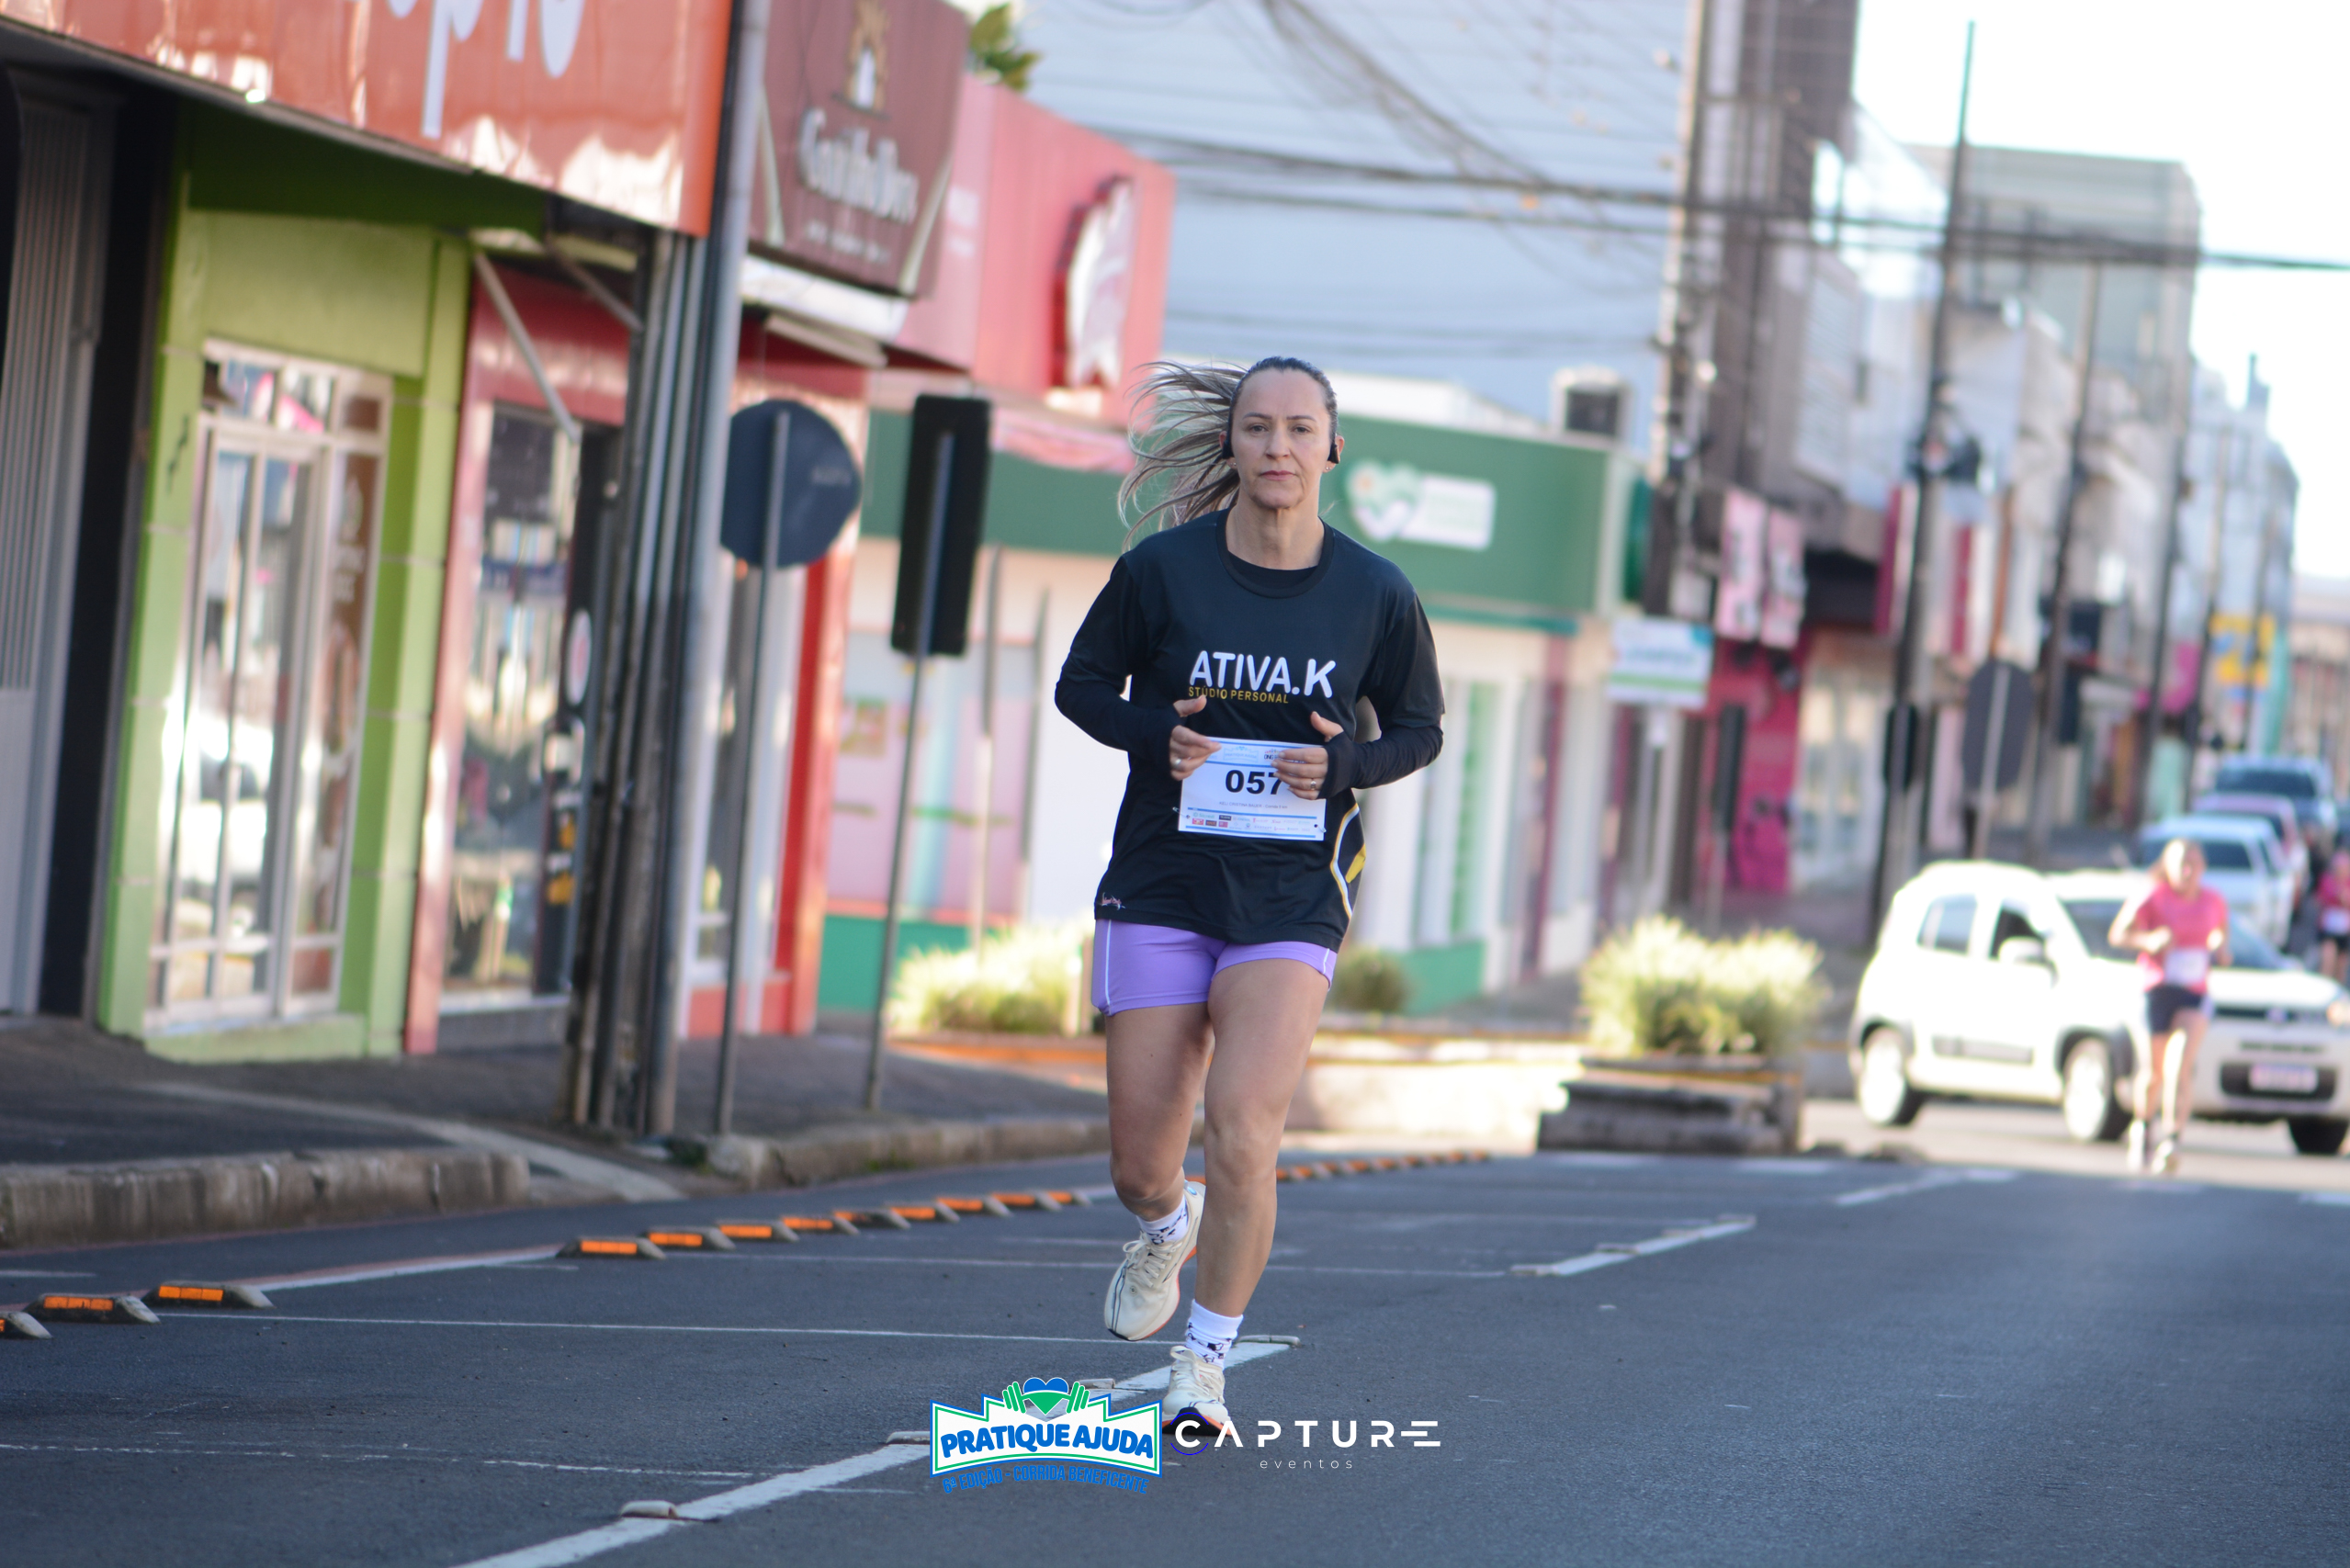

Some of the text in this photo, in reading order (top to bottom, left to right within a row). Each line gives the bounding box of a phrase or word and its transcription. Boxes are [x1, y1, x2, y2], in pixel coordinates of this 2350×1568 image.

[1190, 650, 1337, 698] ATIVA.K
[1230, 689, 1289, 704] PERSONAL
[1226, 770, 1282, 795] 057
